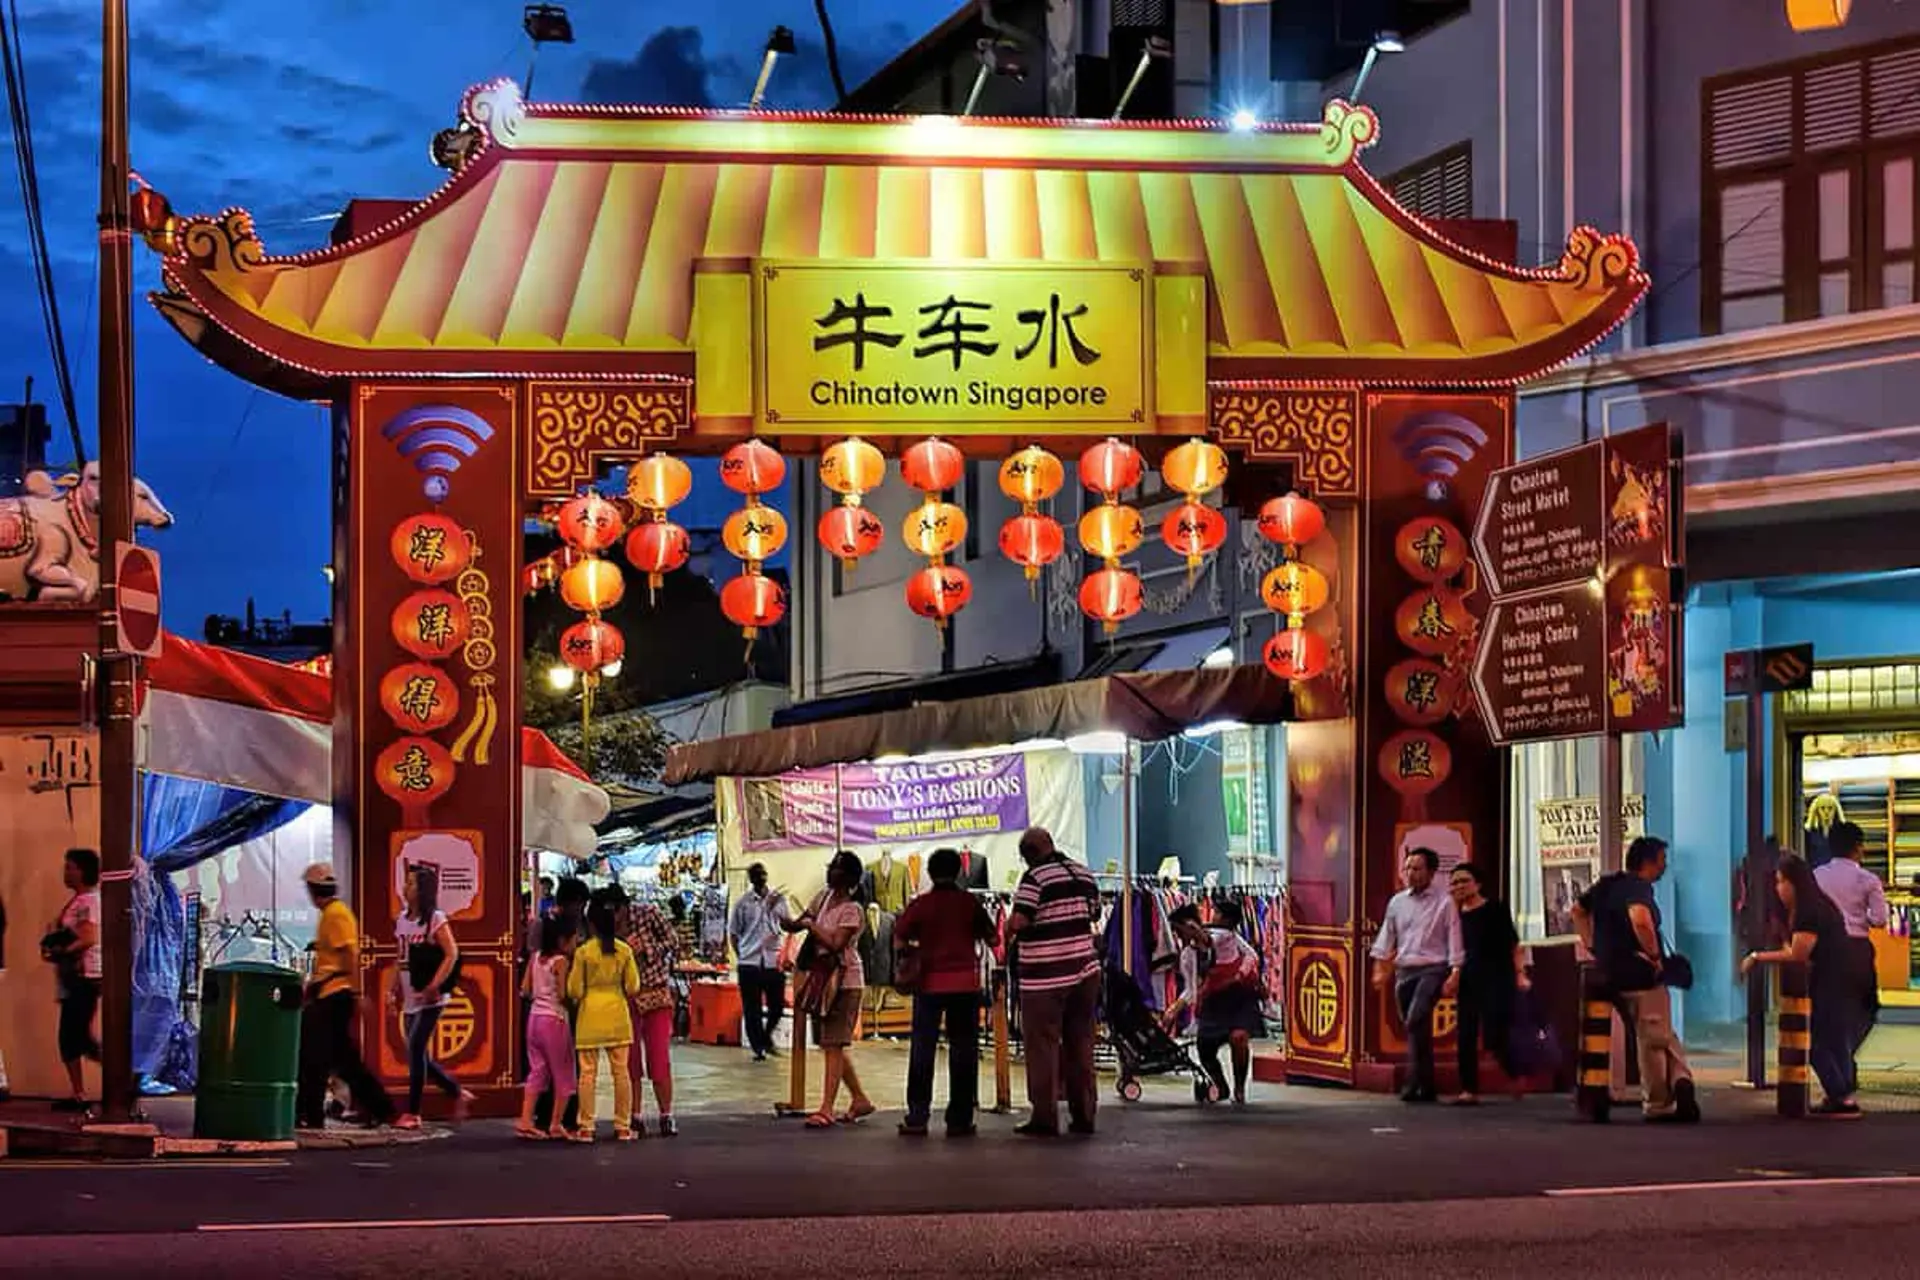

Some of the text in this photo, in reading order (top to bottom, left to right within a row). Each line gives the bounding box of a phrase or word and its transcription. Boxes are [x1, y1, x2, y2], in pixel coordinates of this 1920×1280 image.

[814, 292, 1102, 371] 牛车水
[810, 381, 1107, 410] Chinatown Singapore
[1510, 467, 1559, 495] Chinatown
[1501, 485, 1570, 520] Street Market
[1514, 601, 1564, 625] Chinatown
[1502, 622, 1578, 652] Heritage Centre
[872, 757, 995, 783] TAILORS
[851, 775, 1022, 810] TONY'S FASHIONS
